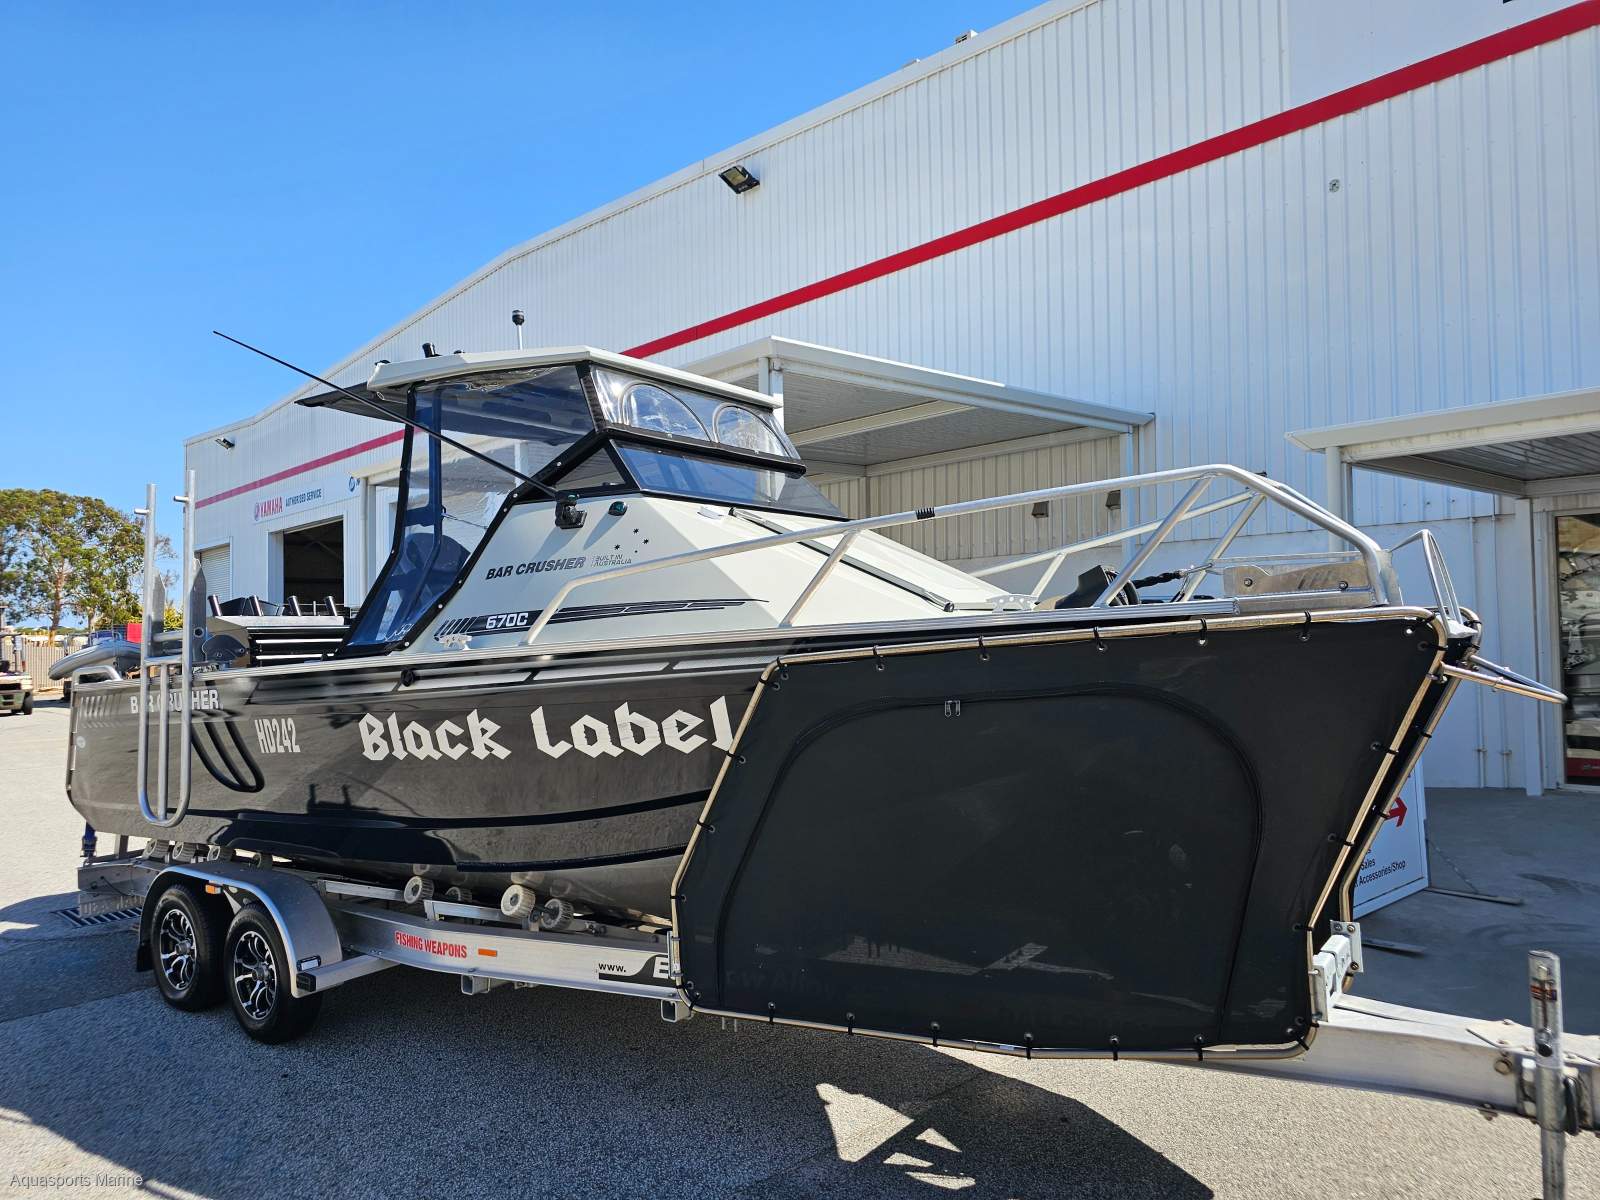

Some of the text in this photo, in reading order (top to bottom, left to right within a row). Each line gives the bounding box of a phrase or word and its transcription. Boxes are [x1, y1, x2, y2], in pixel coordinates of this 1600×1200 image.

[260, 497, 283, 518] YAMAHA
[306, 488, 322, 502] SERVICE
[485, 557, 587, 580] BAR CRUSHER
[594, 559, 632, 567] AUSTRALIA
[485, 612, 529, 629] 670C
[130, 695, 155, 714] BR
[254, 717, 301, 754] HD242
[358, 695, 733, 761] Black Label
[1359, 860, 1406, 886] Accessories/Shop
[395, 931, 468, 959] FISHING WEAPONS
[598, 963, 627, 973] www.
